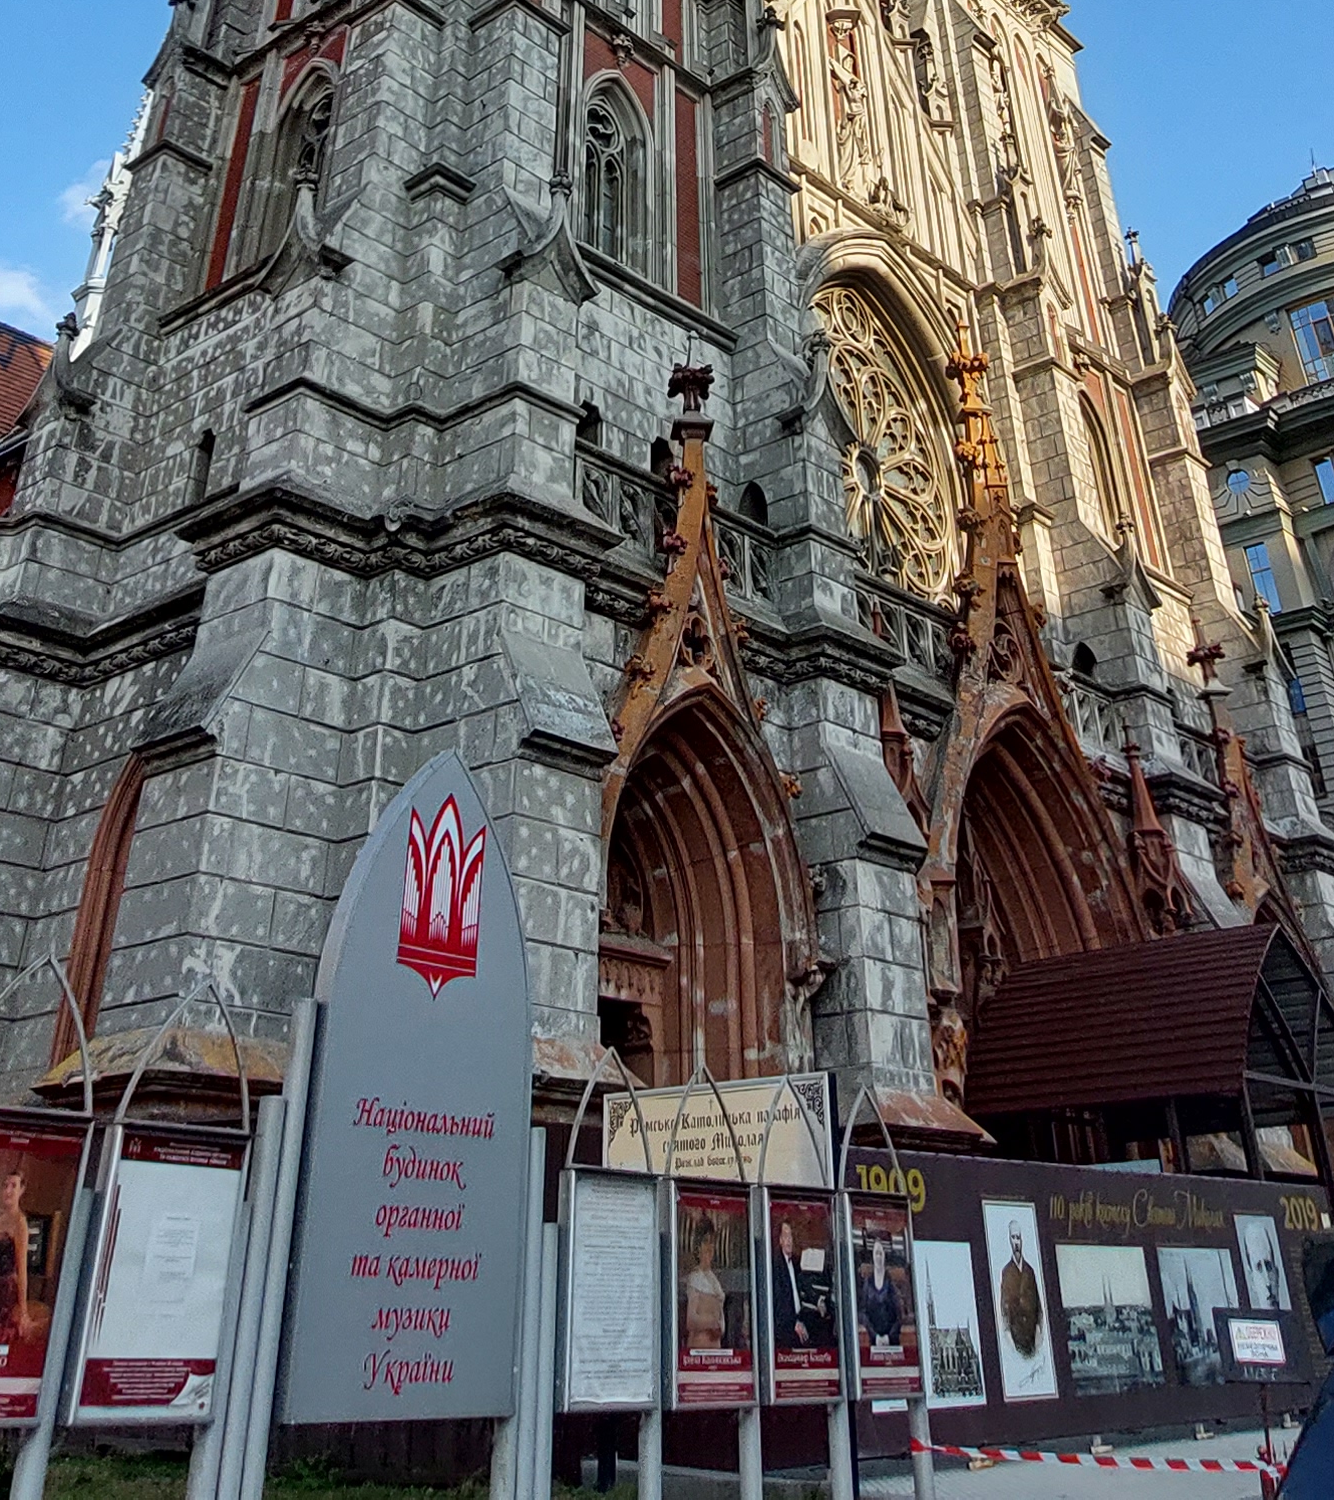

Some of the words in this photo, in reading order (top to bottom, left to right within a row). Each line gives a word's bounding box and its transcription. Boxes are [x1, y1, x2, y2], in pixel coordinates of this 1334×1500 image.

[353, 1097, 495, 1140] Національний
[681, 1111, 751, 1130] Католиька
[757, 1103, 801, 1124] паафія
[711, 1132, 764, 1151] Миолая
[382, 1143, 466, 1190] будинок
[855, 1164, 926, 1214] 1909
[375, 1203, 466, 1238] органної
[1279, 1195, 1319, 1231] 2019
[350, 1253, 381, 1277] та
[386, 1252, 482, 1290] камерної
[371, 1307, 451, 1341] музики
[363, 1349, 454, 1395] України
